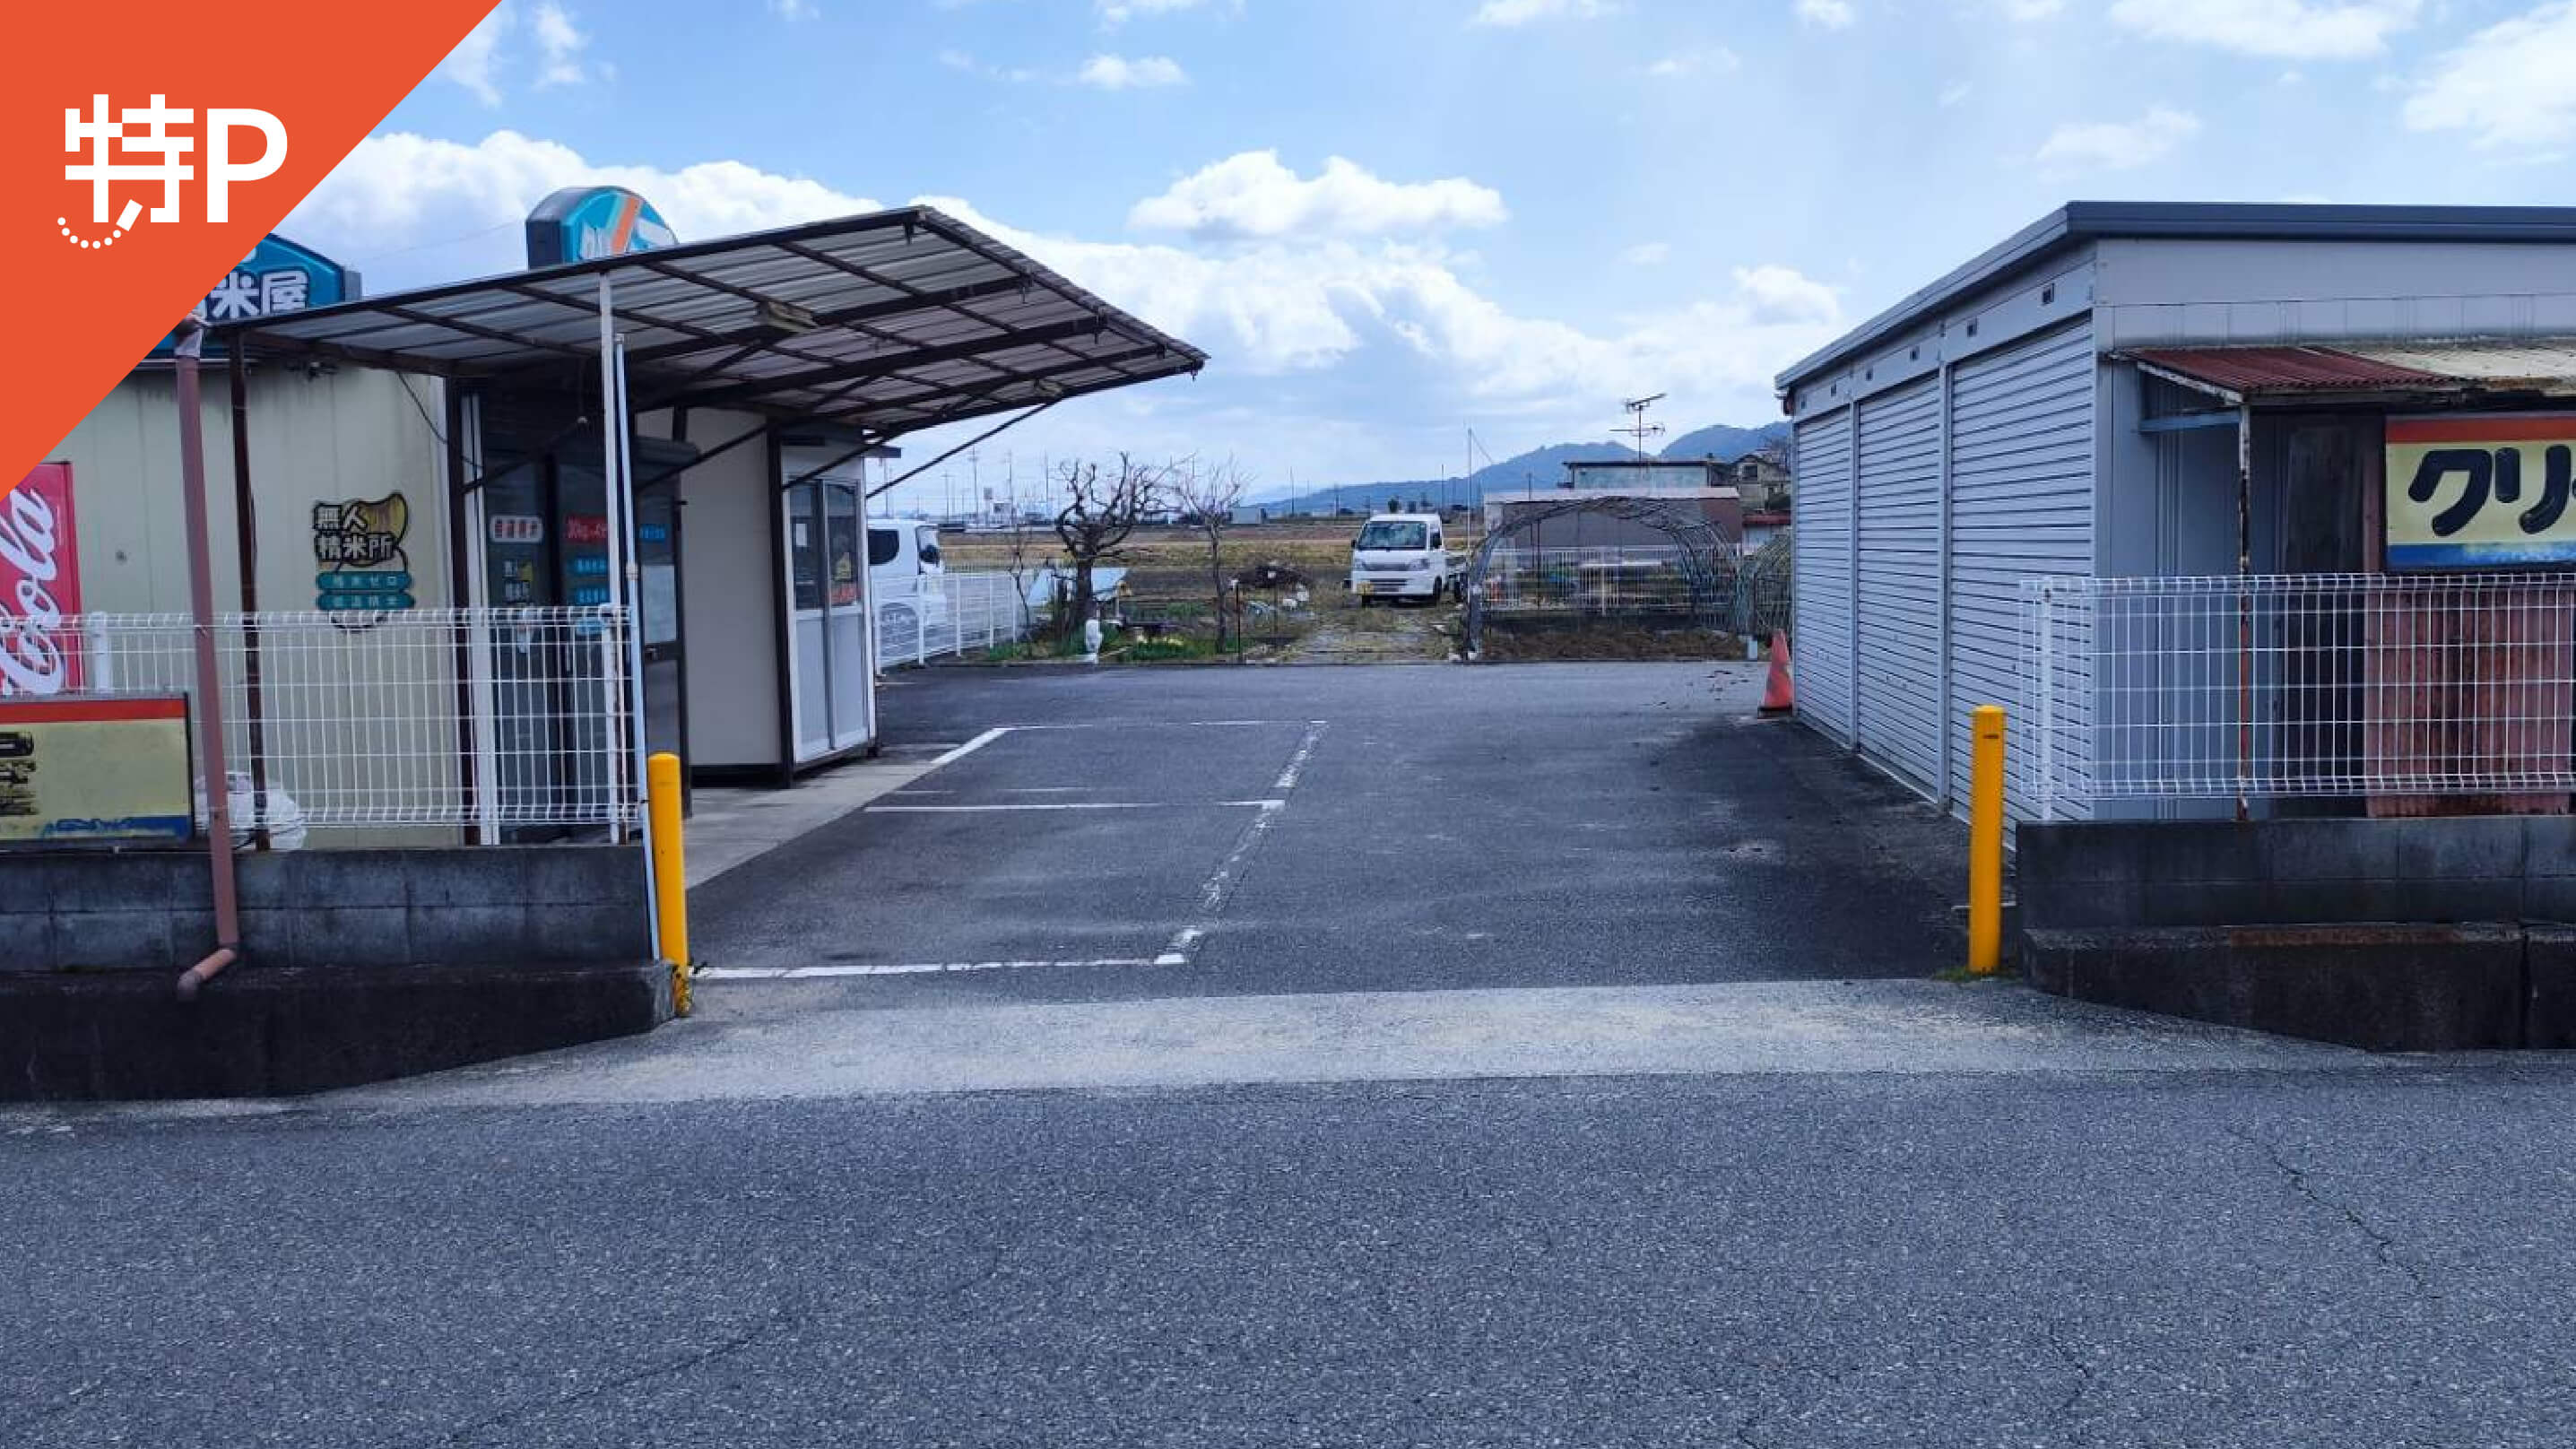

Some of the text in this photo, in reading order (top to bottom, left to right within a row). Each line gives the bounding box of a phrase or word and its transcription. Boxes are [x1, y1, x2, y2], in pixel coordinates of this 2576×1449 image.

[194, 271, 308, 319] 米屋
[2408, 445, 2576, 536] クリ
[316, 504, 368, 531] 無人
[317, 534, 395, 560] 精米所
